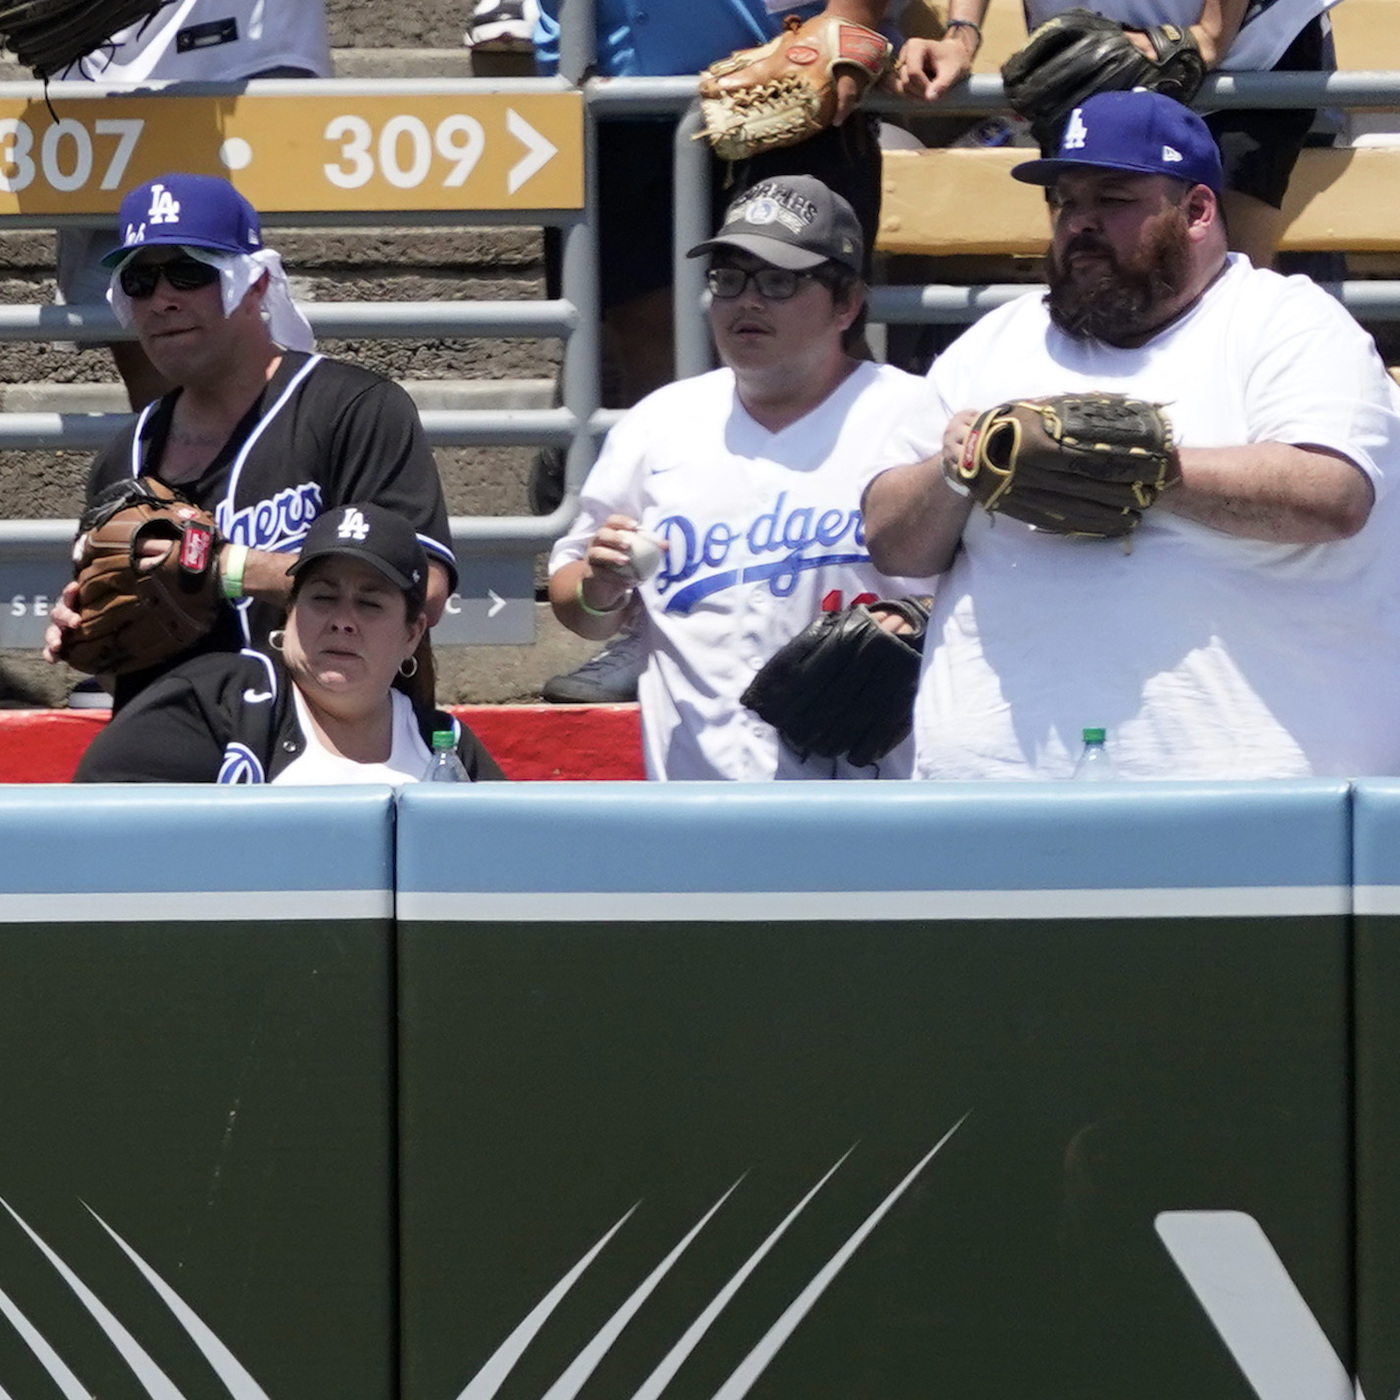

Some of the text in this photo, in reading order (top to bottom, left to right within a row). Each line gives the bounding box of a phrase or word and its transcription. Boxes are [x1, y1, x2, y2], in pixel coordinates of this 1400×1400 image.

[323, 114, 486, 190] 309
[148, 184, 180, 225] LA
[652, 491, 868, 598] Dodger
[11, 594, 50, 617] SE
